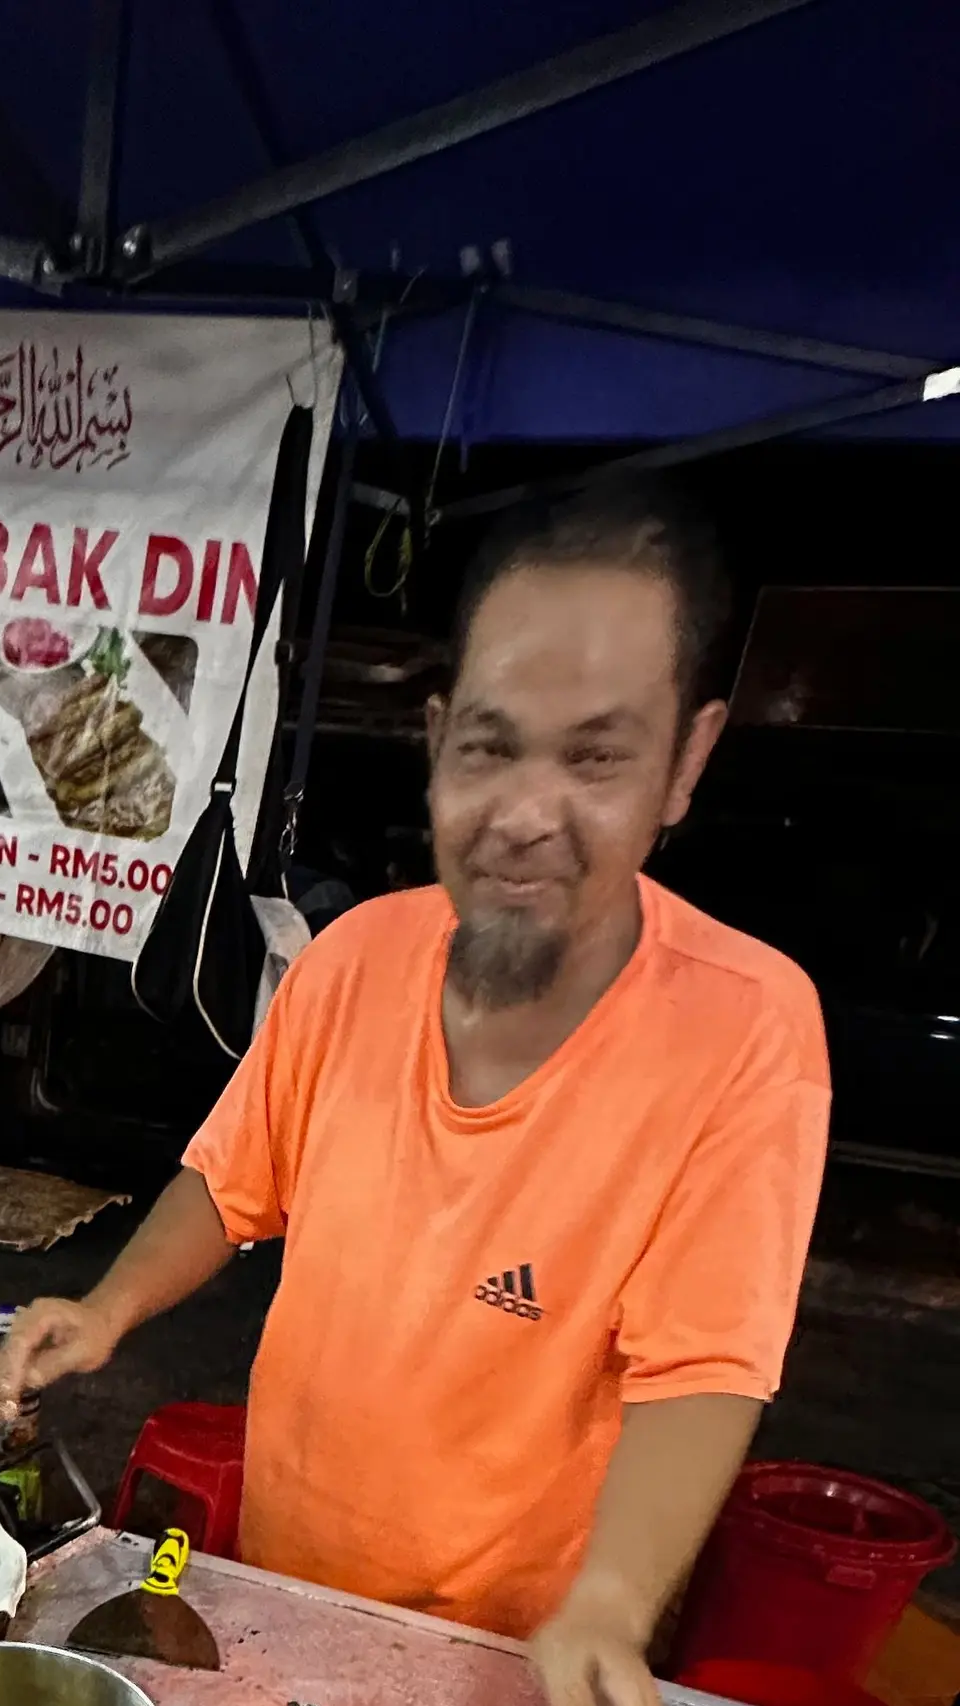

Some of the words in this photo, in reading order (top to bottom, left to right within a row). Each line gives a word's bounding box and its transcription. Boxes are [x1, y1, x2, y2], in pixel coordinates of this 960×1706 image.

[49, 843, 173, 895] RM5.00
[15, 882, 135, 936] RM5.00
[474, 1284, 544, 1321] adidas
